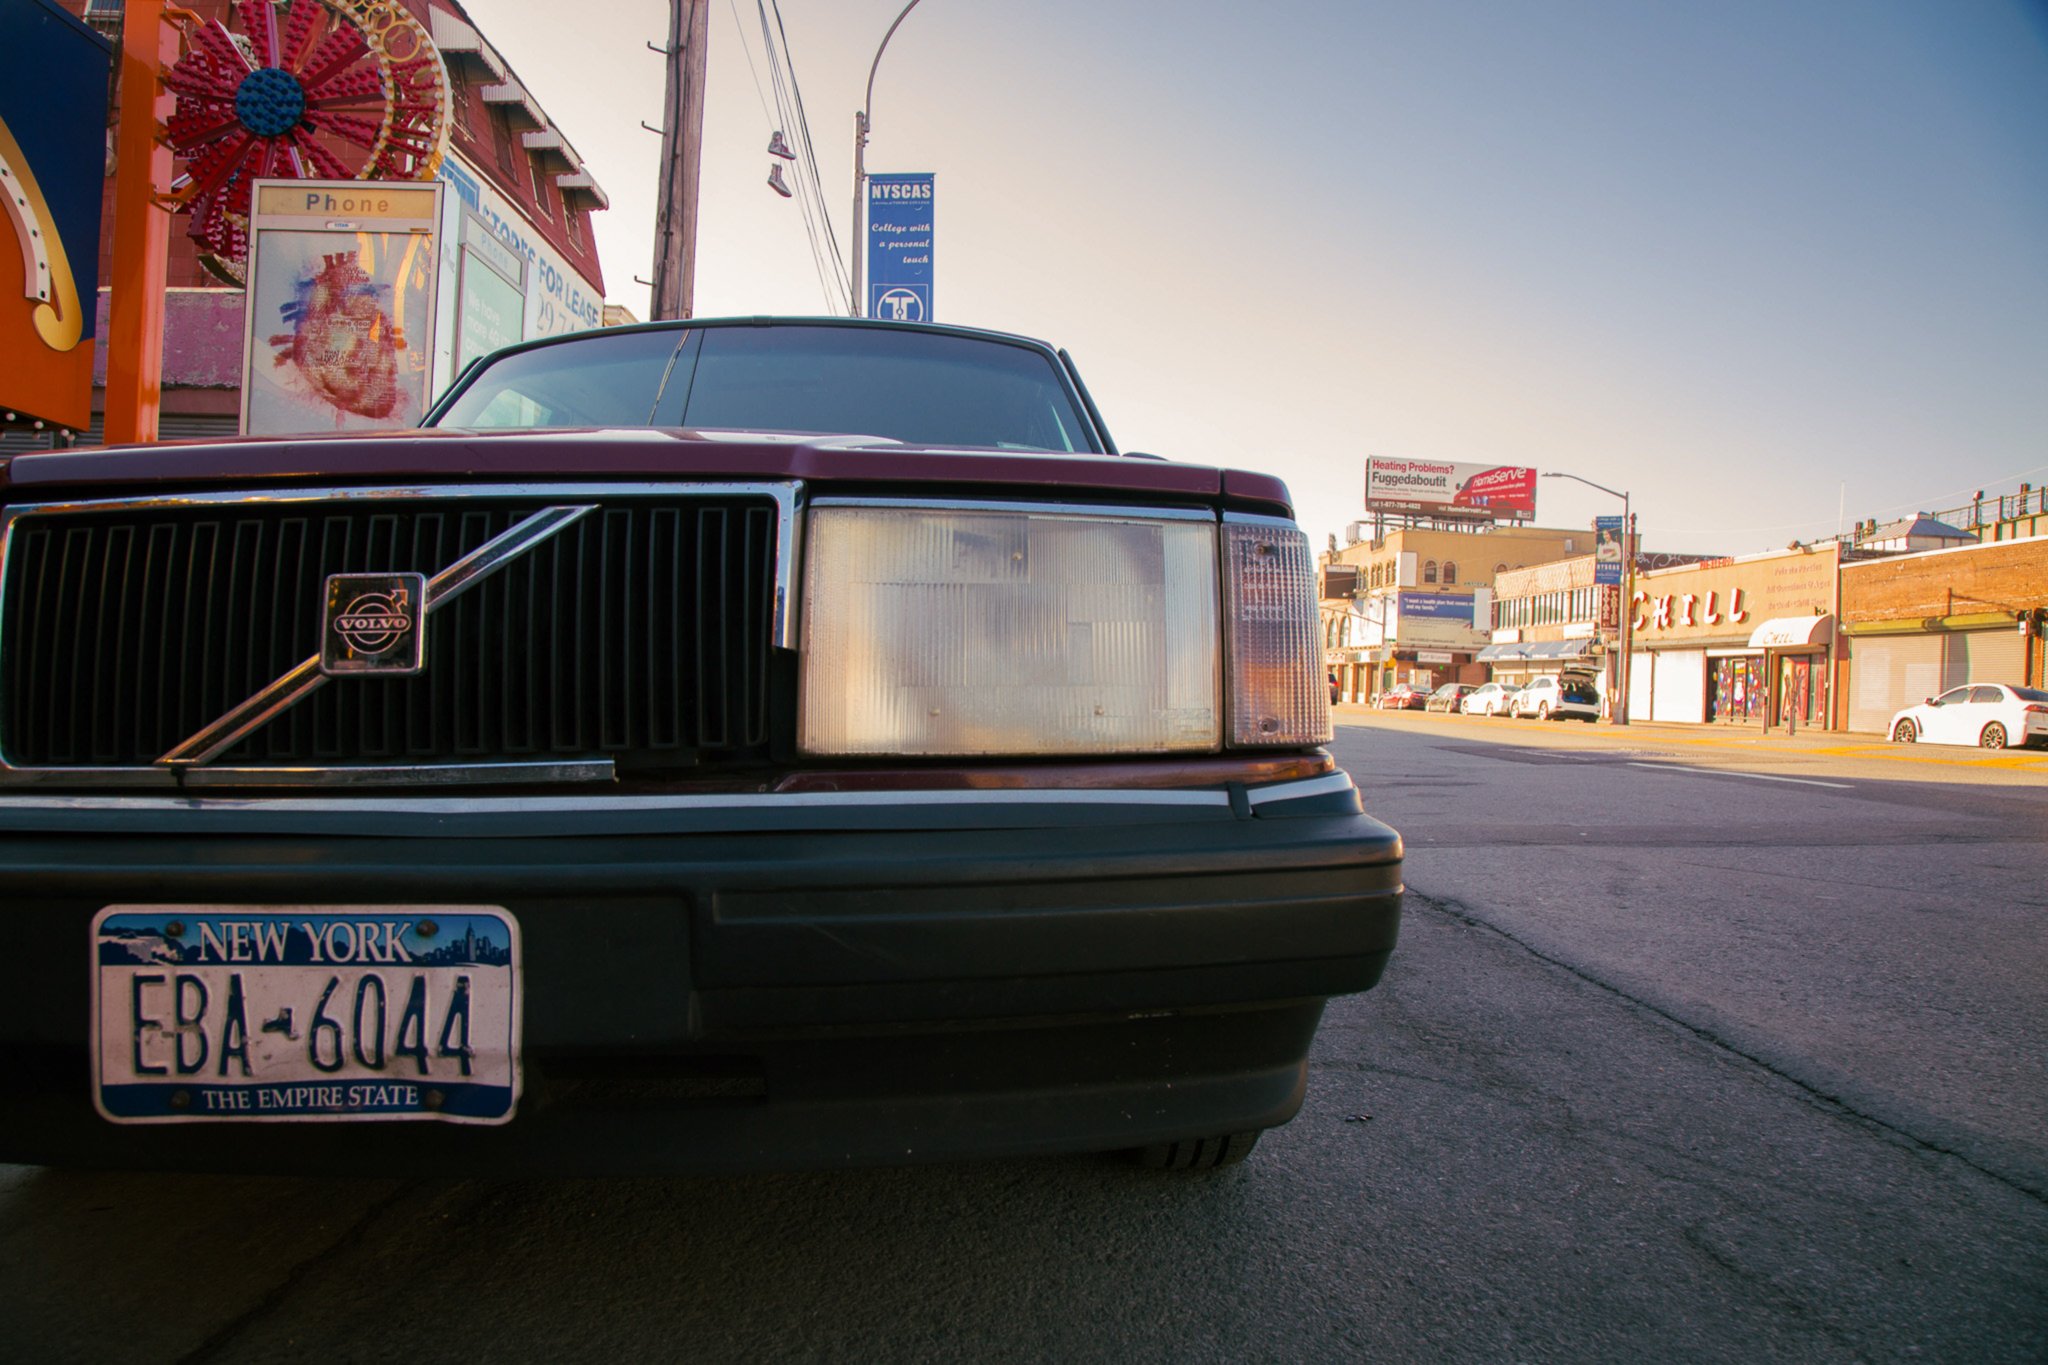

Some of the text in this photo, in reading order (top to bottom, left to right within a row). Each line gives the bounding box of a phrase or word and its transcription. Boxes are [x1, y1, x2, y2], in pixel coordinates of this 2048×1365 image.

[872, 184, 931, 199] NYSCAS
[306, 194, 389, 212] Phone
[872, 223, 930, 234] College with
[888, 239, 930, 250] personal
[902, 255, 929, 264] touch
[539, 256, 564, 297] FOR
[565, 282, 599, 329] LEASE
[481, 298, 501, 326] have
[467, 315, 487, 339] more
[1372, 459, 1455, 475] Heating Problems?
[1372, 471, 1447, 487] Fuggedaboutit
[1472, 467, 1527, 488] HomeServe
[1633, 588, 1746, 631] CHILL
[340, 618, 408, 630] VOLVO
[1763, 631, 1794, 645] CHILL
[197, 921, 412, 963] NEW YORK
[201, 1085, 419, 1111] THE EMPIRE STATE
